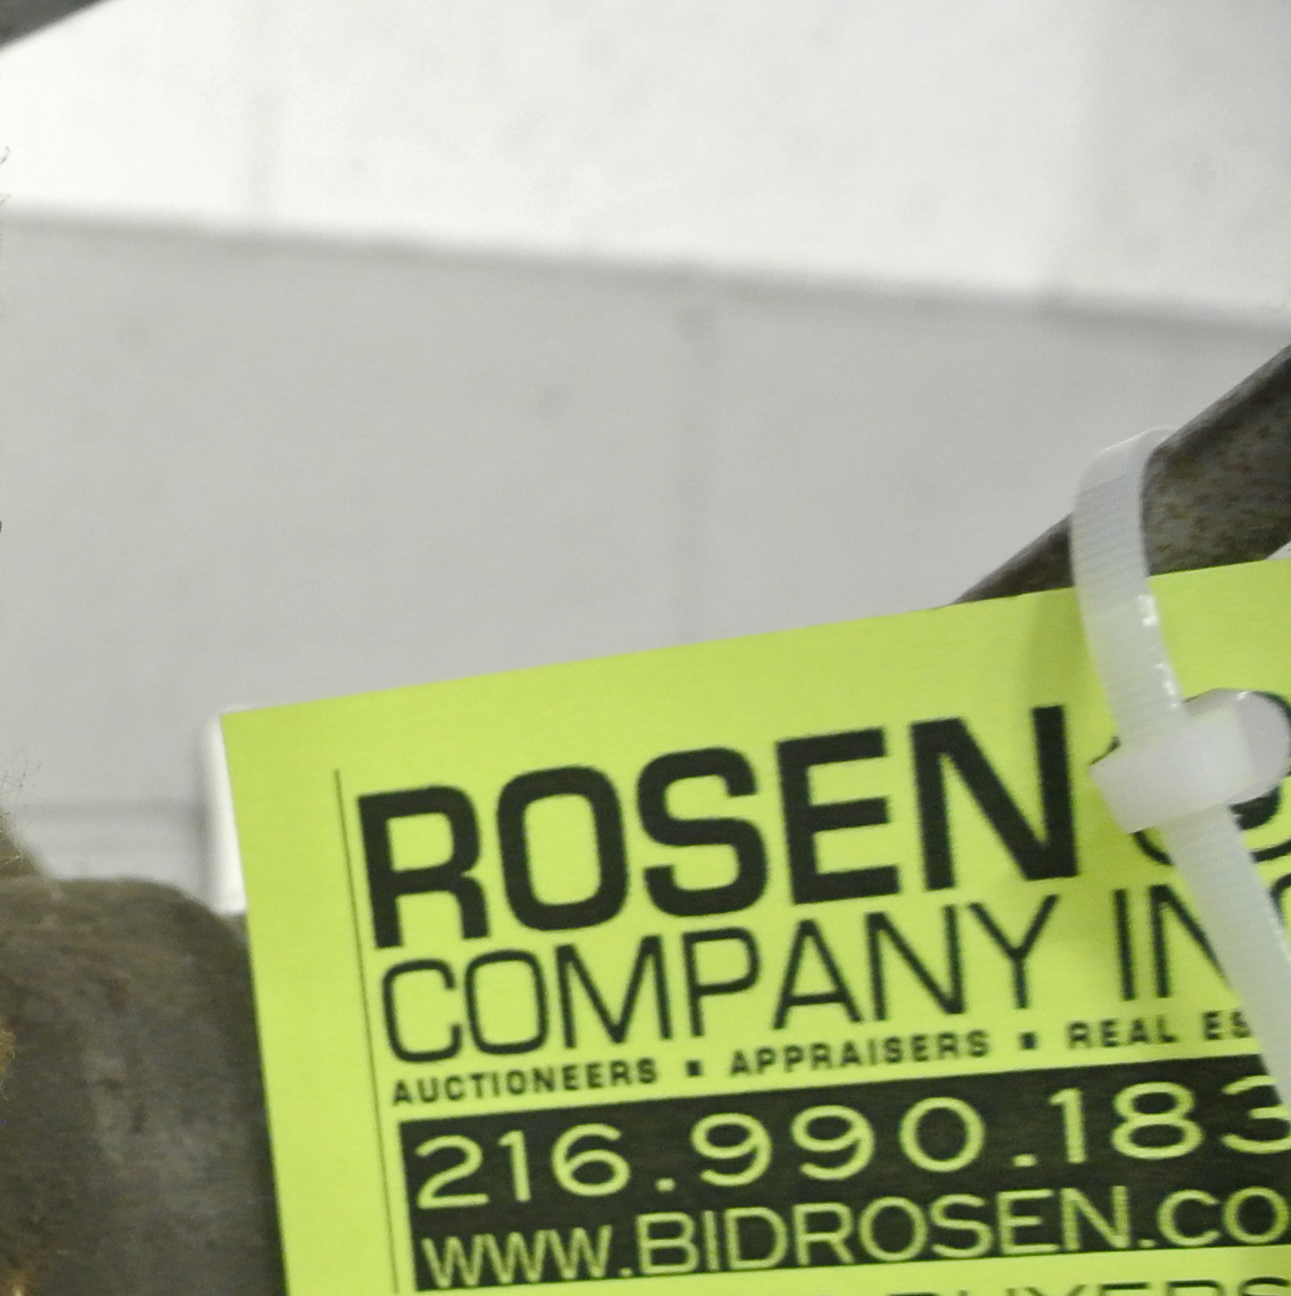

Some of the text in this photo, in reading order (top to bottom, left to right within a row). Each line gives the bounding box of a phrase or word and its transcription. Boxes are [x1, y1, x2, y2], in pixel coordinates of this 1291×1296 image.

[357, 705, 1080, 949] ROSEN
[381, 893, 1059, 1065] COMPANY
[392, 1009, 1254, 1106] AUCTIONEERS APPRAISERS REAL ES
[415, 1075, 1291, 1209] 216.990.183
